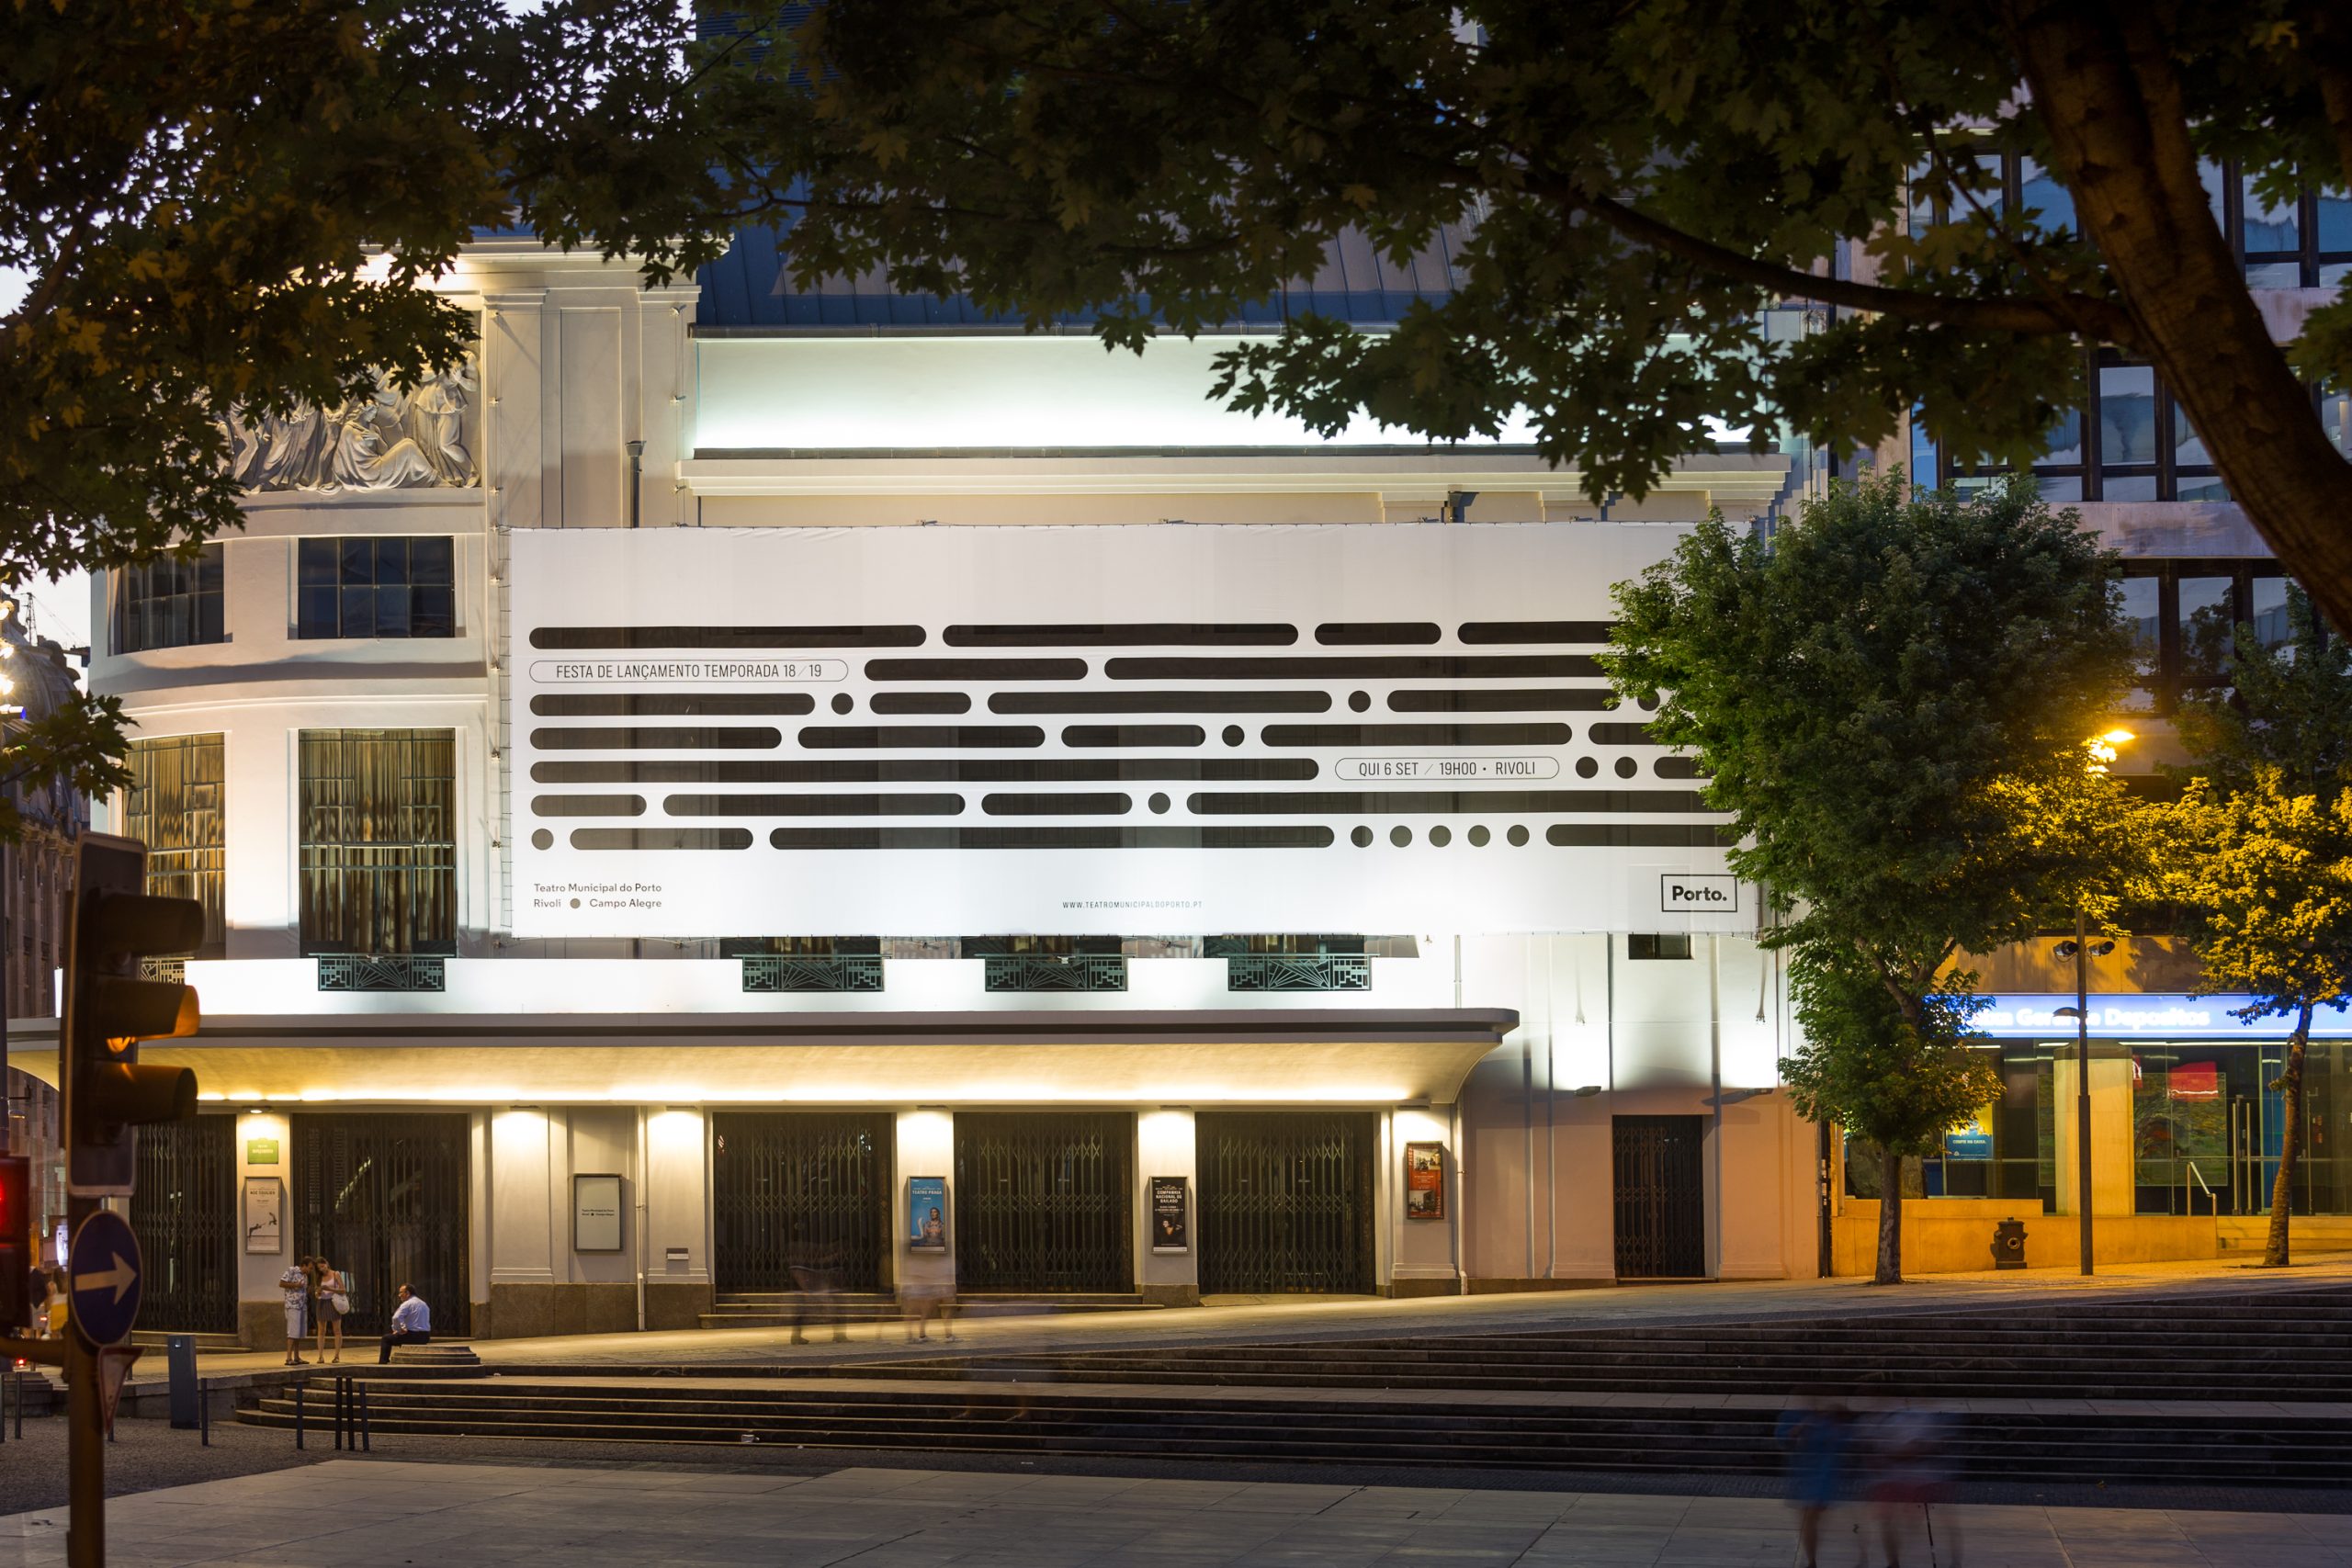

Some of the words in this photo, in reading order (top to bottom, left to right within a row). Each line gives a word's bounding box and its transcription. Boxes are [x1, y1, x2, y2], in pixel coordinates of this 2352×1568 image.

[556, 664, 594, 679] FESTA
[597, 664, 613, 679] DE
[616, 664, 700, 681] LANÇAMENTO
[704, 664, 779, 679] TEMPORADA
[1359, 762, 1380, 777] QUI
[1384, 762, 1392, 775] 6
[1396, 762, 1419, 775] SET
[1440, 761, 1476, 775] 19H00
[1496, 761, 1535, 775] RIVOLI
[534, 883, 566, 893] Teatro
[568, 883, 617, 894] Municipal
[619, 883, 632, 893] do
[635, 883, 662, 893] Porto
[1672, 885, 1728, 902] Porto.
[534, 898, 561, 908] Rivoli
[589, 898, 627, 909] Campo
[628, 898, 662, 909] Alegre
[1062, 900, 1203, 909] WWW.TEATROMUNICIPALDOPORTO.PT
